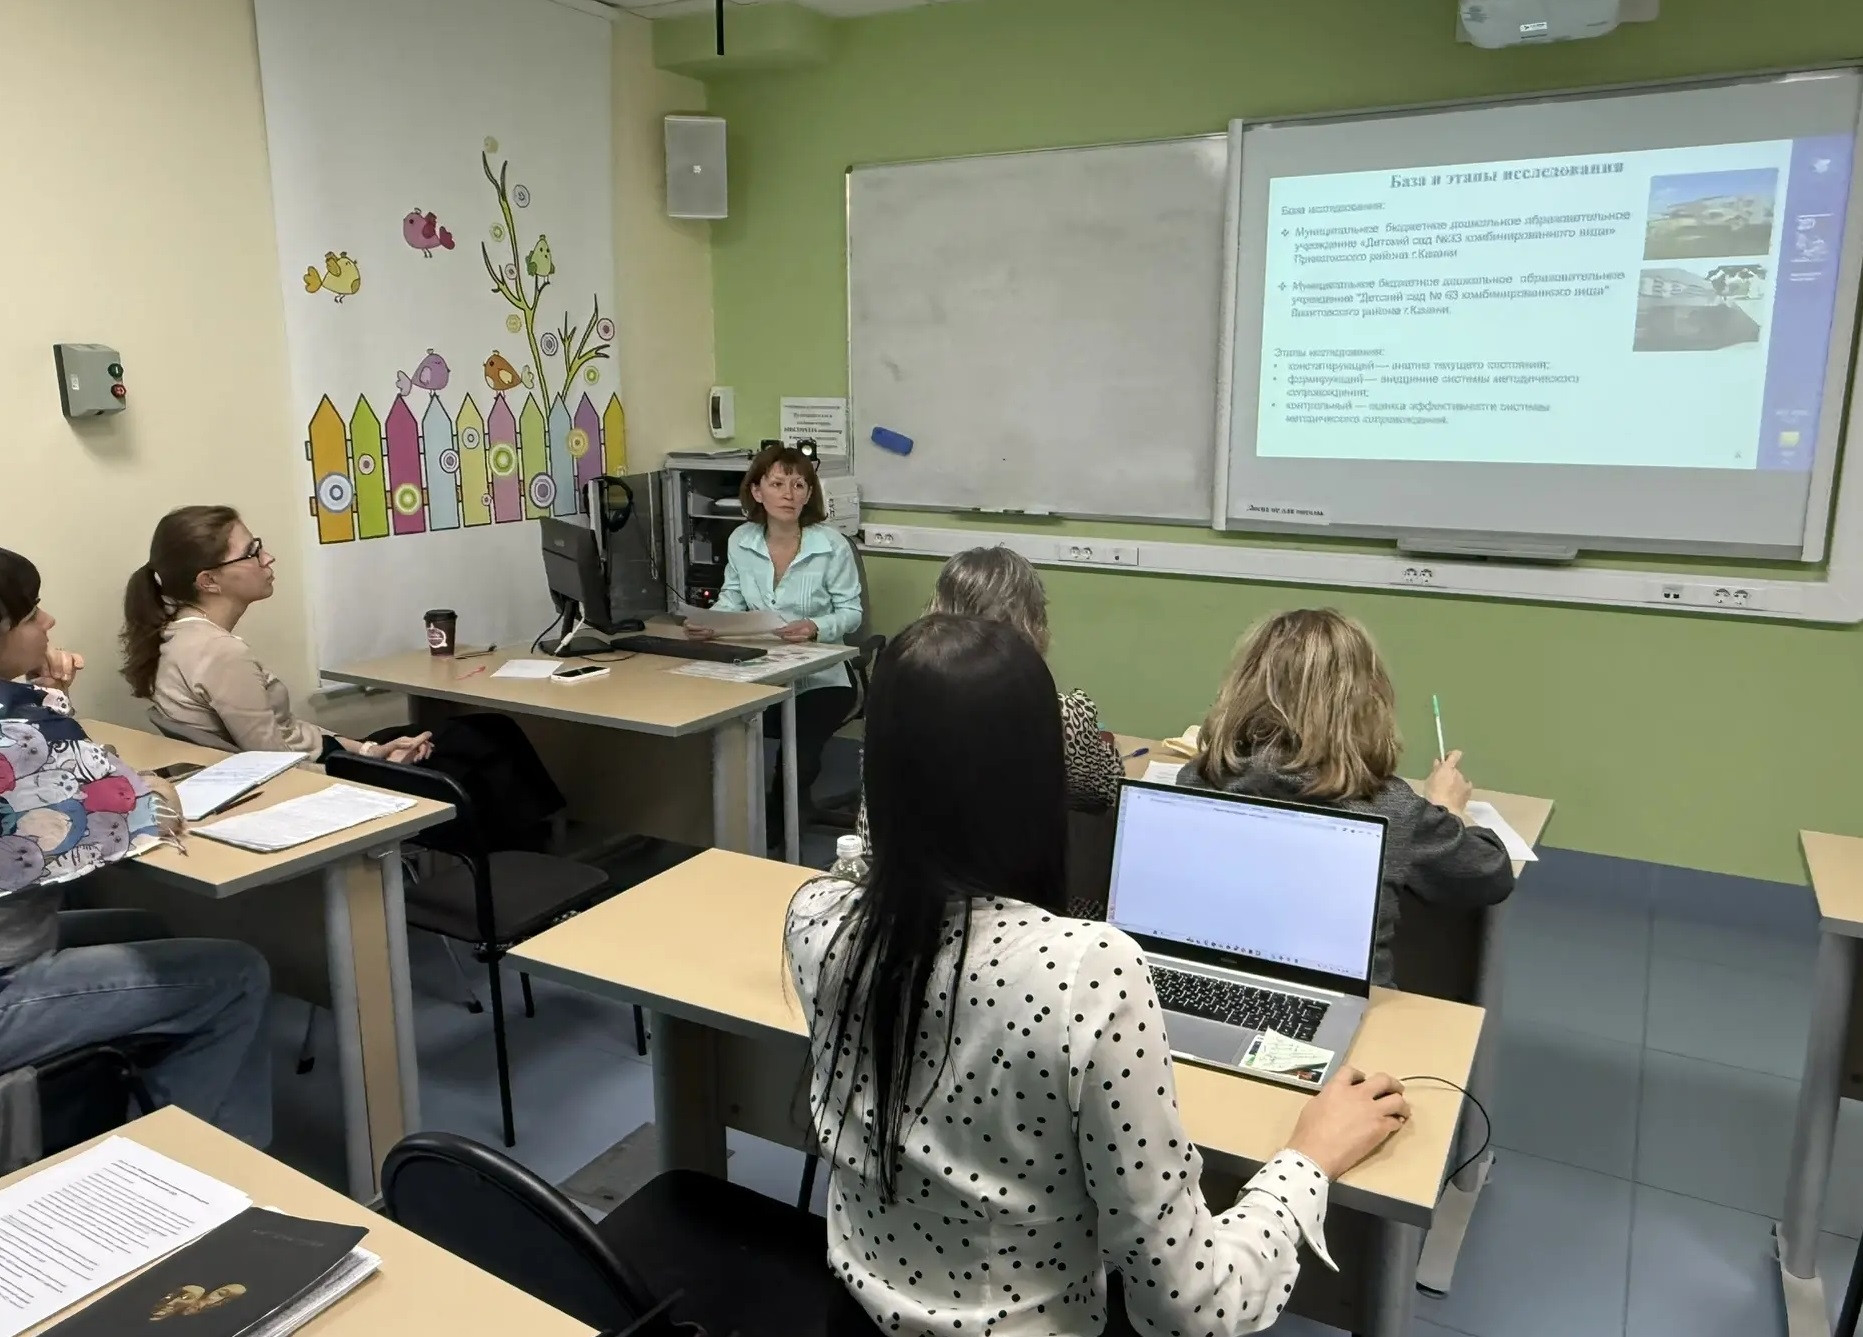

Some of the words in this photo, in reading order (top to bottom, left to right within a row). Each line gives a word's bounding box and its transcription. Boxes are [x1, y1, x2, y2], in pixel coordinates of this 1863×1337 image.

[1391, 174, 1426, 189] База
[1431, 174, 1441, 186] и
[1446, 170, 1498, 185] этапы
[1503, 162, 1624, 181] исследования
[1295, 225, 1379, 240] Муниципальное
[1385, 221, 1447, 234] бюджетное
[1449, 216, 1522, 231] дошкольное
[1412, 236, 1432, 247] сад
